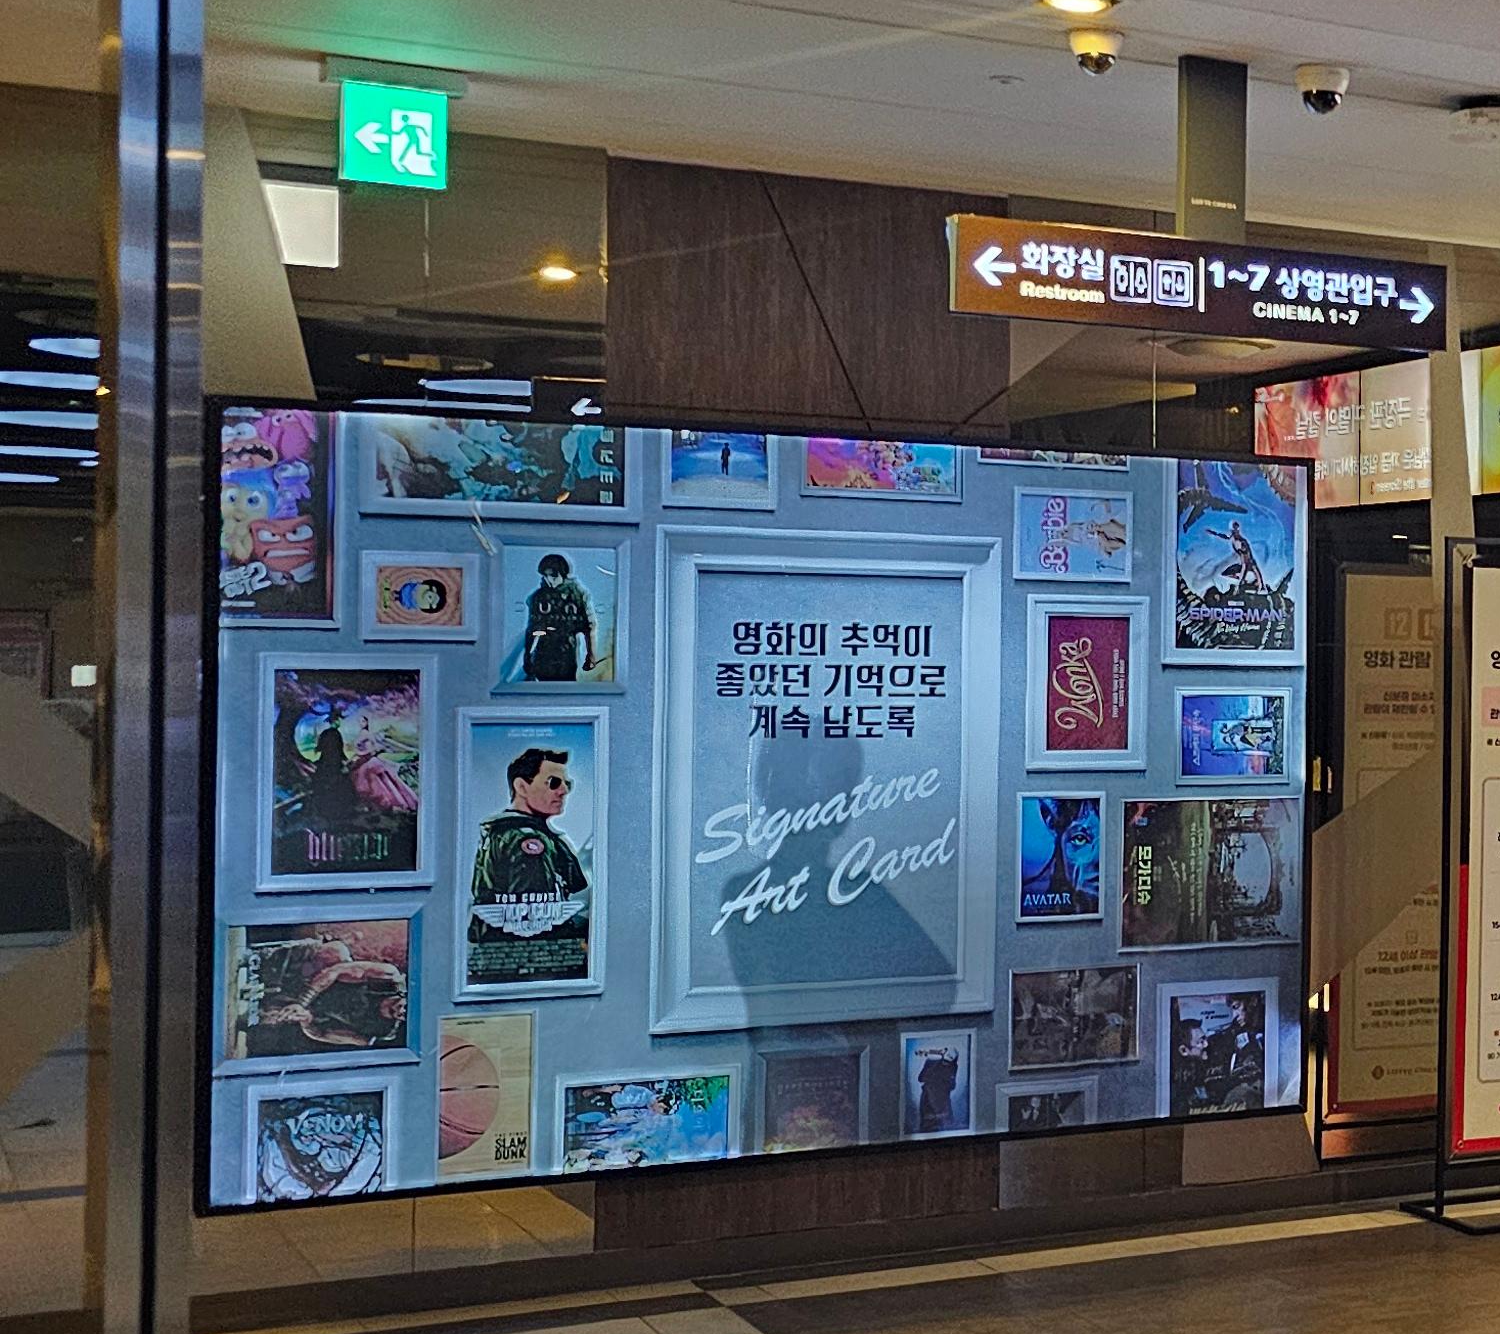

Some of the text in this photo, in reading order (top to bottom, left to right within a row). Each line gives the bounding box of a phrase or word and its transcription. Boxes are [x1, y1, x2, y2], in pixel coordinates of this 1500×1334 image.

[1021, 241, 1398, 308] 화장실 1~7 상영관입구
[1020, 280, 1105, 304] Restroom
[1252, 301, 1360, 325] CINEMA 1~7
[732, 620, 932, 657] 영화의 추억이
[1364, 650, 1395, 668] 영화
[715, 662, 947, 698] 좋았던 기억으로
[749, 705, 916, 739] 계속 남도록
[694, 767, 941, 865] Signature
[710, 818, 957, 937] Art Card
[1137, 845, 1152, 906] 모가디슈
[1023, 893, 1072, 907] AVATAR
[494, 1148, 527, 1160] DUNK
[495, 1137, 527, 1149] SLAM
